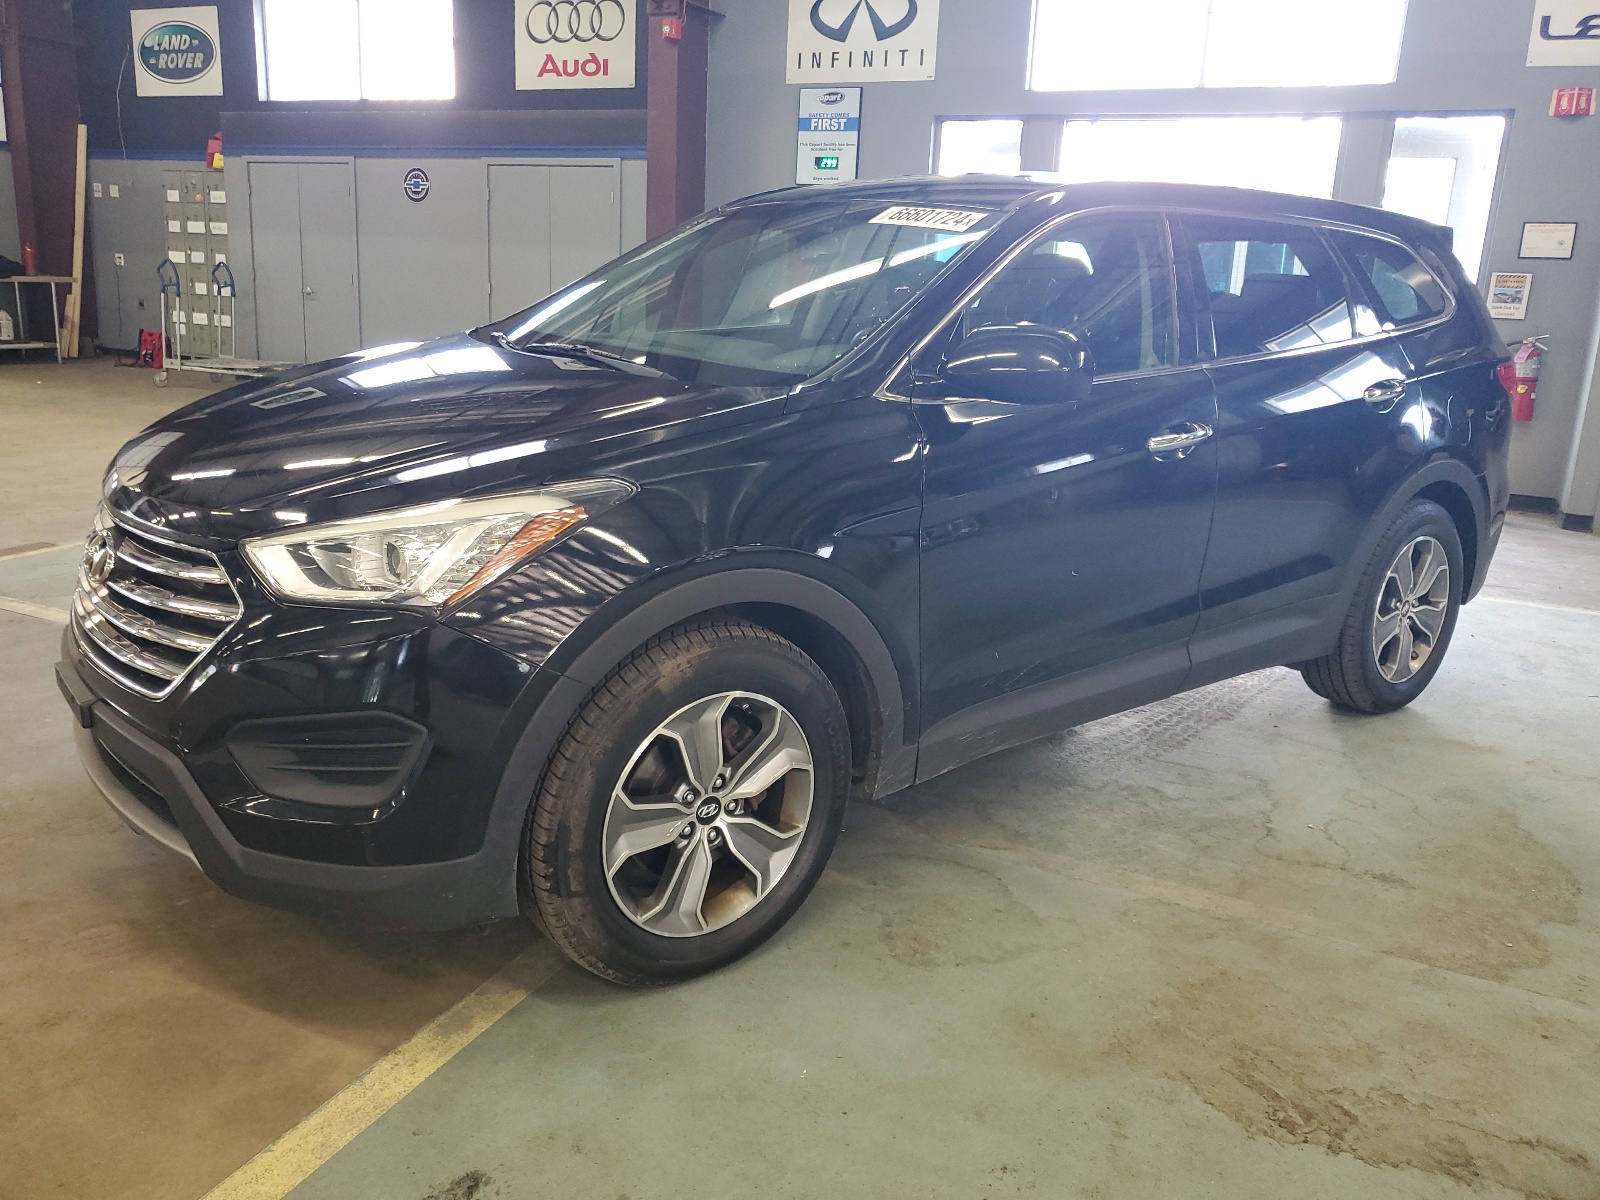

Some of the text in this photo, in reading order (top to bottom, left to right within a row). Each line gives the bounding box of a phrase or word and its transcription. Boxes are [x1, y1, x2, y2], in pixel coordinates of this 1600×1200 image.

[153, 34, 190, 51] LAND
[158, 52, 204, 69] ROVER
[537, 52, 609, 78] Audi
[797, 49, 925, 69] INFINITI
[810, 118, 848, 131] FIRST
[888, 207, 973, 227] 66601724
